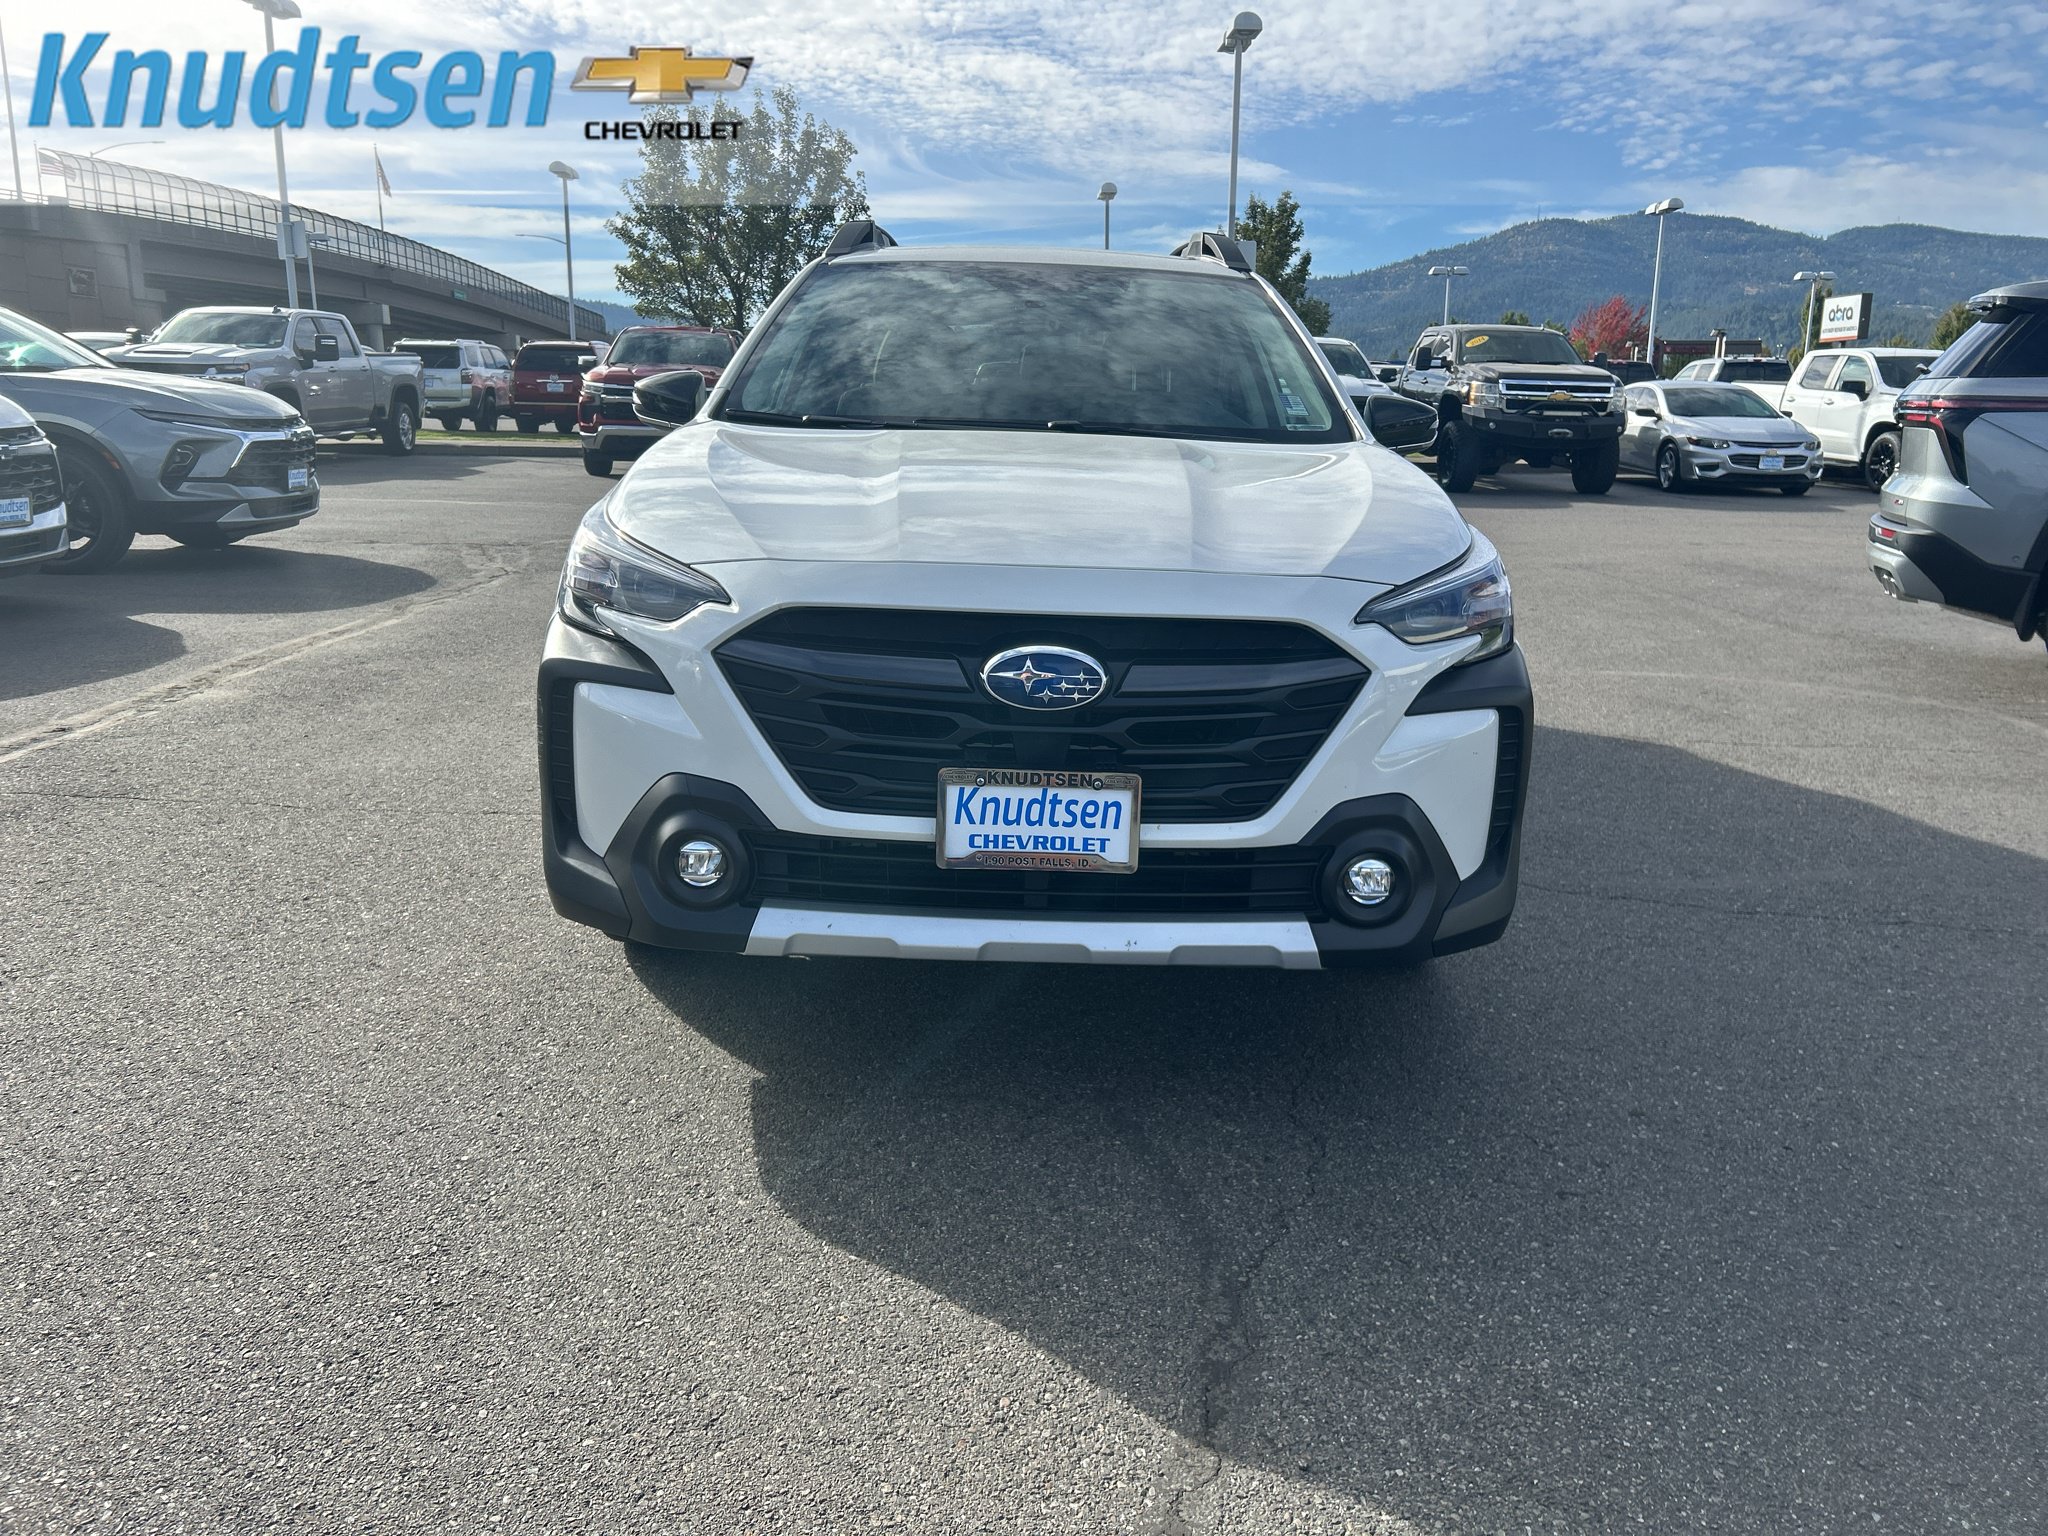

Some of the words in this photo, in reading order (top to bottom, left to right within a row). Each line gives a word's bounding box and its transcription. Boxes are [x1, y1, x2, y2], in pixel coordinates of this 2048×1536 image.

[1829, 304, 1853, 321] abra
[986, 771, 1093, 787] KNUDTSEN
[954, 787, 1122, 829] Knudtsen
[968, 834, 1110, 853] CHEVROLET
[1008, 857, 1036, 866] POST
